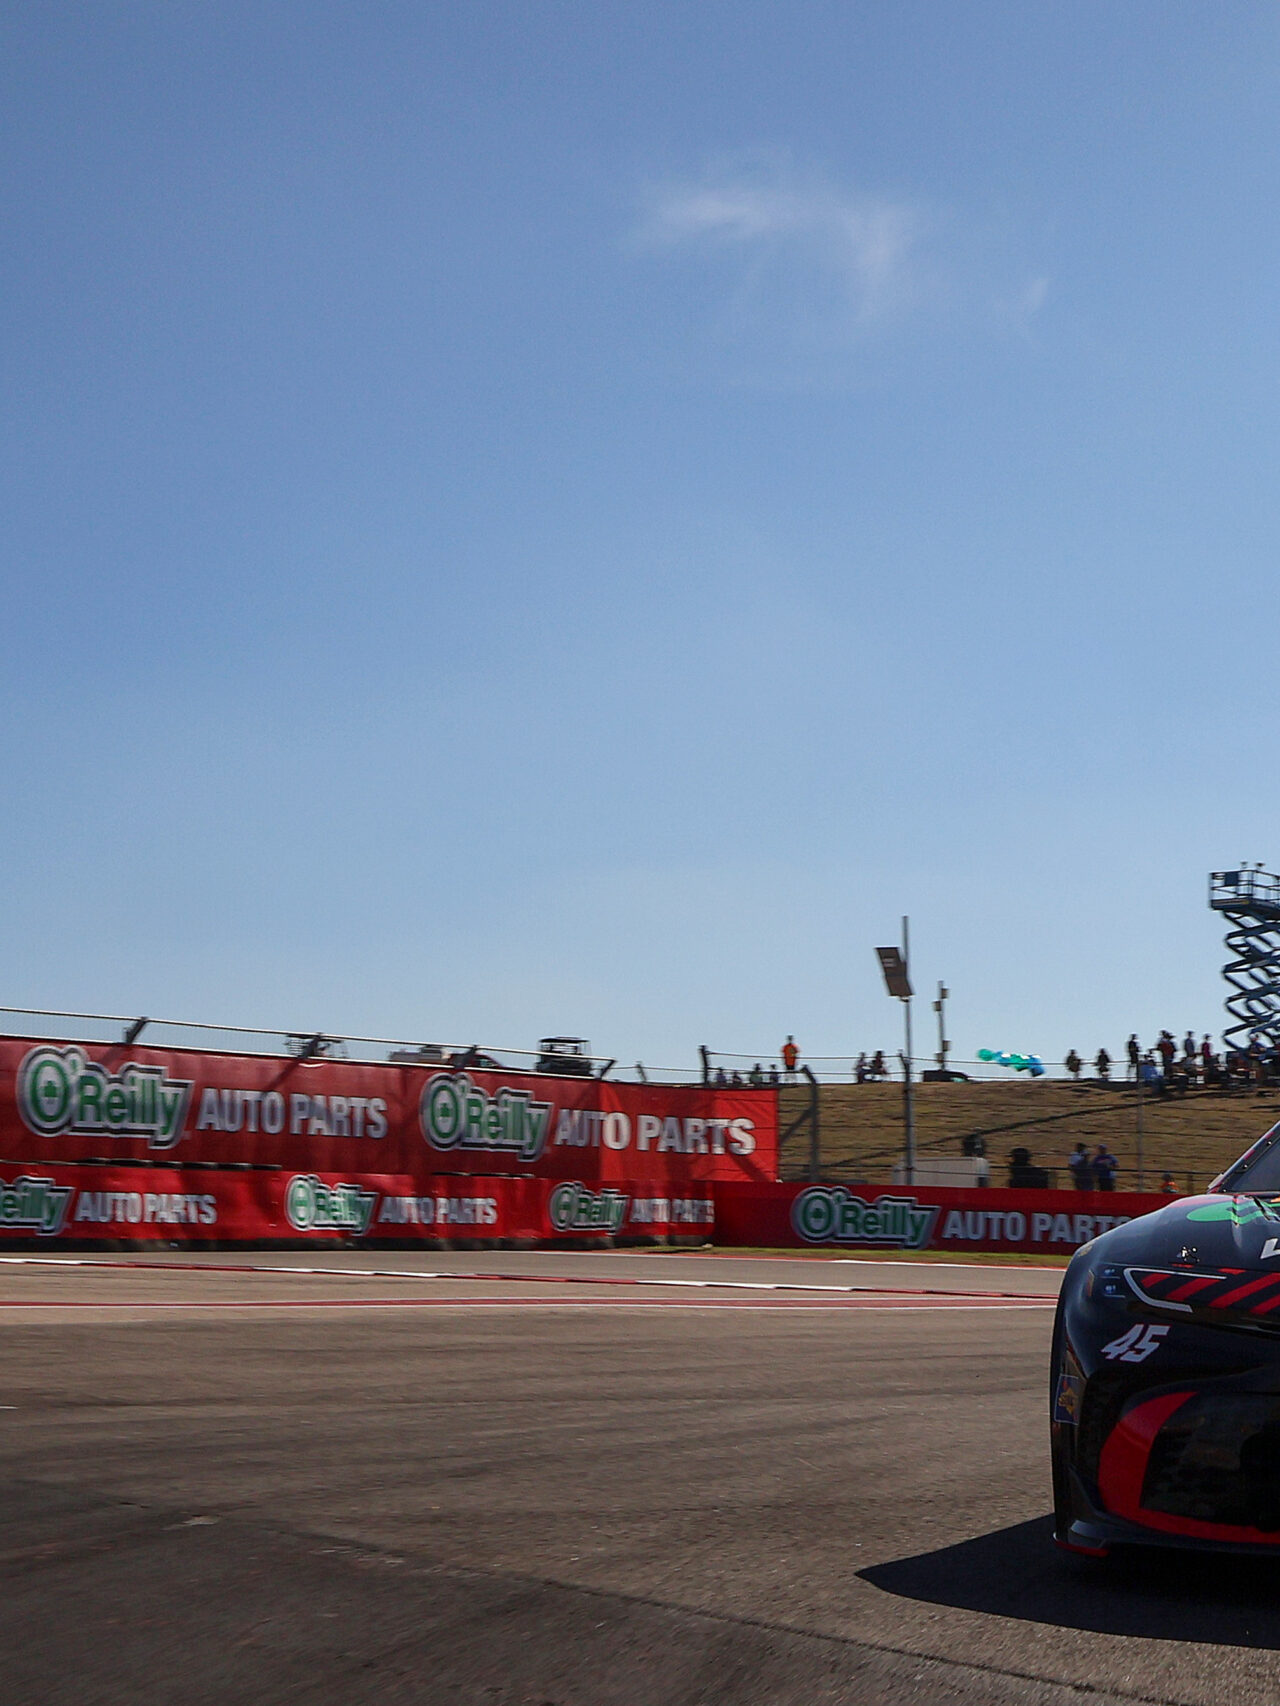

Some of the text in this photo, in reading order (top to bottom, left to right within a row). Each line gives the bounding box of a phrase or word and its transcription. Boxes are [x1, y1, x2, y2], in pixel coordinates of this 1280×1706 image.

[25, 1052, 388, 1141] O'Reilly AUTO PARTS
[427, 1077, 756, 1157] O'Reilly AUTO PARTS
[74, 1191, 142, 1223] AUTO
[143, 1193, 217, 1224] PARTS
[377, 1196, 434, 1224] AUTO
[436, 1197, 497, 1224] PARTS
[798, 1190, 935, 1248] O'Reilly
[943, 1211, 1027, 1241] AUTO
[1101, 1323, 1171, 1362] 45
